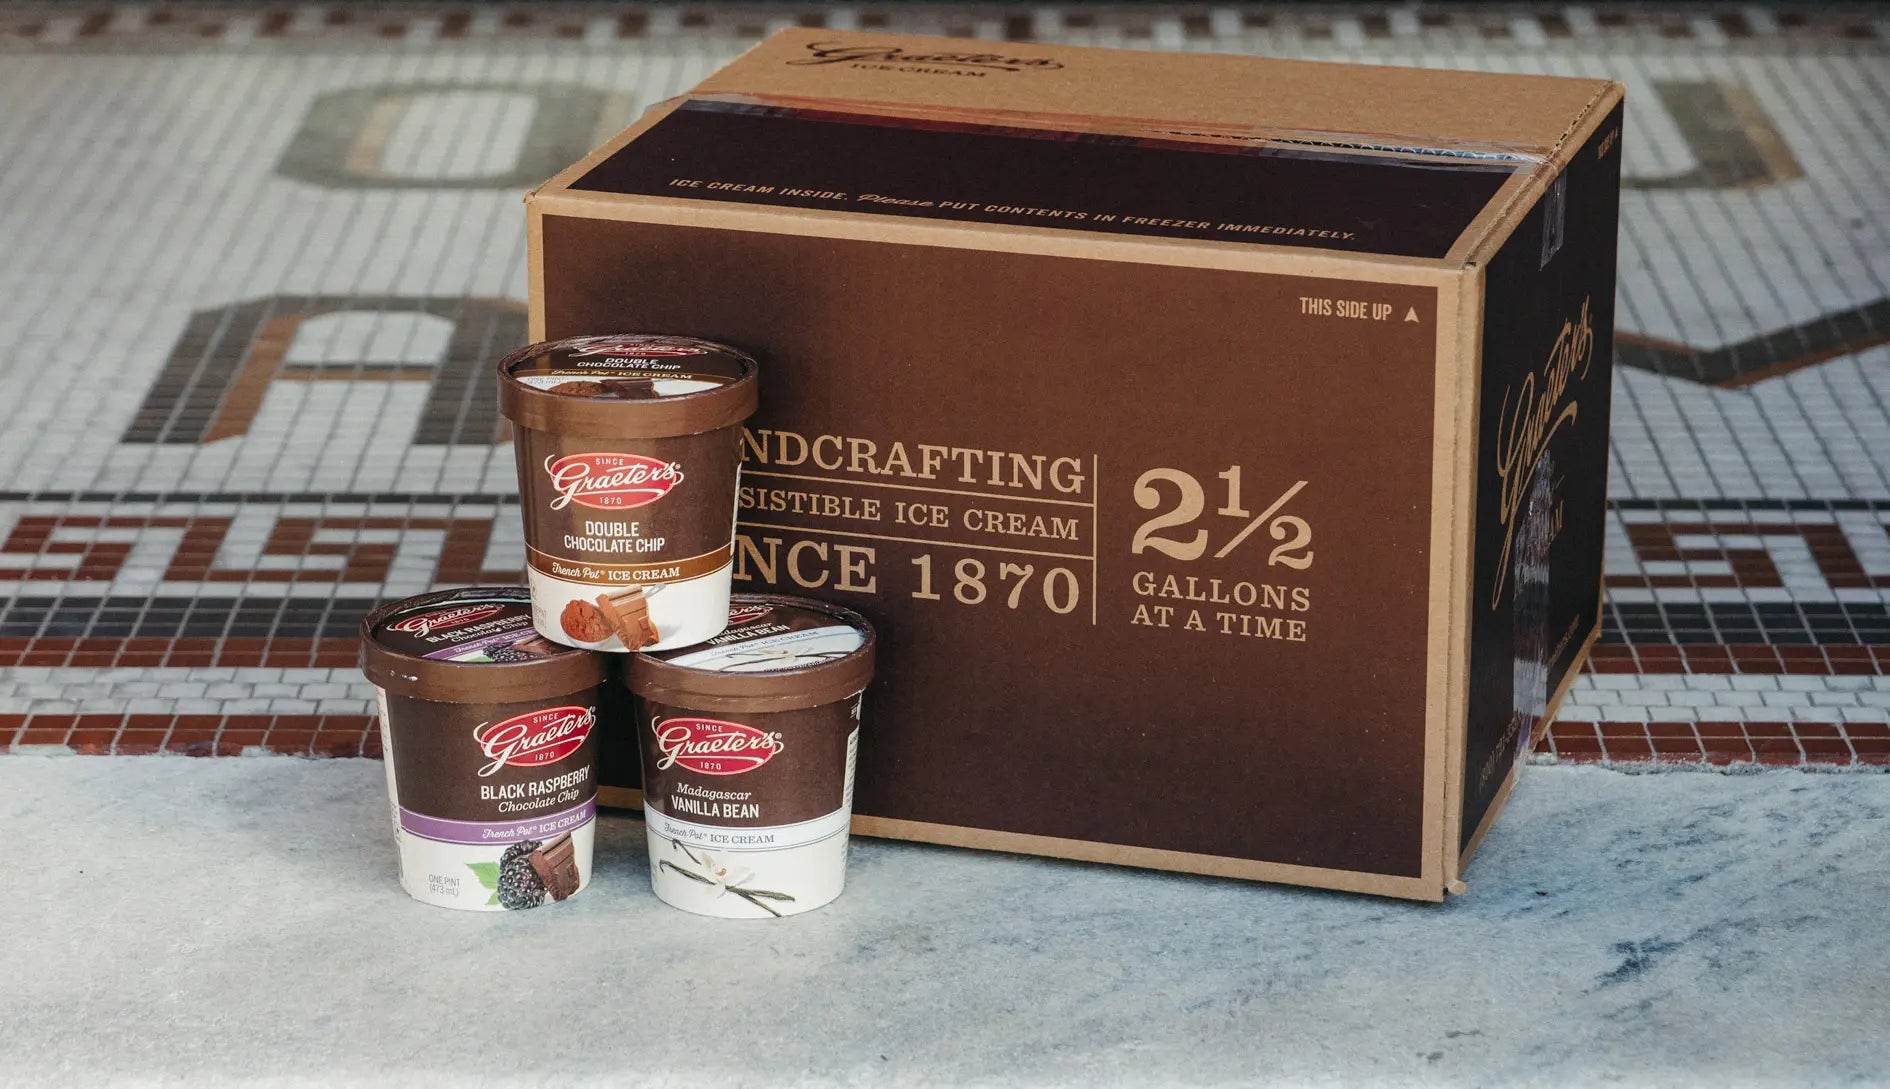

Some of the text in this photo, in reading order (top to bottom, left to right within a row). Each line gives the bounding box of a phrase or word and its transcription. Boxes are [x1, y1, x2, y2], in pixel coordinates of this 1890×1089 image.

[852, 63, 986, 78] ICE CREAM
[670, 178, 1356, 241] ICE CREAM INSIDE. Please PUT CONTENTS IN FREEZER IMMEDIATELY.
[1299, 296, 1393, 321] THIS SIDE UP
[576, 361, 650, 369] CHOCOLATE
[604, 357, 660, 365] DOUBLE
[643, 372, 693, 380] CREAM
[595, 457, 624, 466] SINCE
[741, 428, 1086, 494] NDCRAFTING
[544, 454, 685, 511] Graeter's
[599, 496, 622, 505] 1870
[738, 486, 1080, 541] SISTIBLE ICE CREAM
[585, 520, 640, 537] DOUBLE
[564, 534, 665, 553] CHOCOLATE CHIP
[552, 562, 582, 578] French
[608, 570, 631, 581] ICE
[635, 567, 681, 581] CREAM
[733, 534, 1081, 615] NCE 1870
[1132, 571, 1311, 612] GALLONS
[425, 629, 466, 643] BLACK
[467, 614, 532, 634] RASPBERRY
[451, 621, 529, 643] Chocolate Chip
[719, 622, 773, 636] dagascar
[1130, 604, 1307, 642] AT A TIME
[706, 624, 791, 645] VANILLA BEAN
[532, 712, 559, 724] SINCE
[695, 723, 723, 733] SINCE
[473, 706, 596, 777] Graeter's
[651, 716, 784, 771] Graeter's
[535, 751, 555, 761] 1870
[700, 761, 722, 771] 1870
[480, 764, 591, 800] BLACK RASPBERRY
[676, 782, 752, 801] Madagascar
[498, 788, 580, 813] Chocolate Chip
[671, 795, 760, 819] VANILLA BEAN
[482, 828, 515, 839] French
[539, 823, 556, 833] ICE
[557, 810, 587, 829] CREAM
[664, 822, 688, 837] French
[710, 834, 729, 844] ICE
[731, 834, 775, 844] CREAM
[429, 874, 460, 887] ONE PINT
